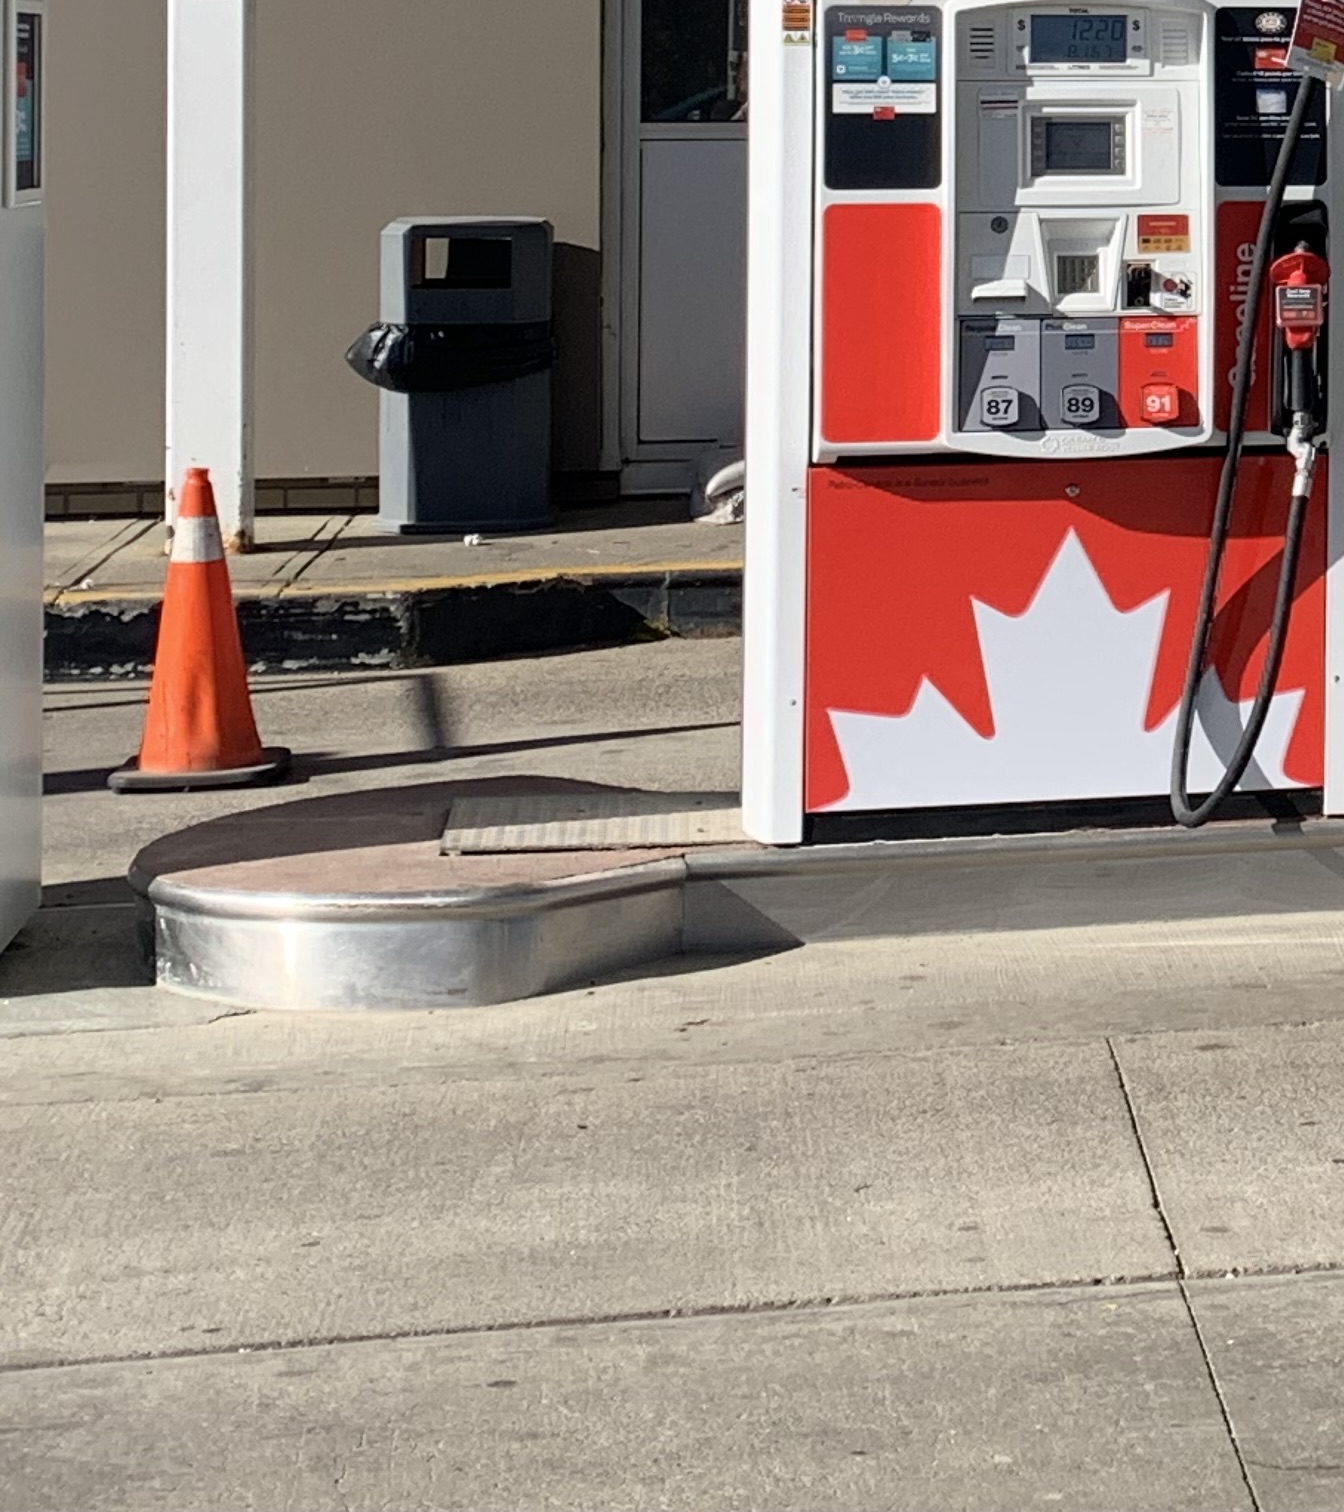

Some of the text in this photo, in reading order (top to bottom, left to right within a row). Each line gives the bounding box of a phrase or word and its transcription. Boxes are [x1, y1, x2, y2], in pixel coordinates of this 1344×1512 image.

[837, 12, 931, 26] Triangle Rewards
[1016, 18, 1027, 32] $
[1131, 18, 1142, 32] $
[986, 399, 1013, 415] 87
[1067, 397, 1095, 413] 89
[1146, 397, 1171, 412] 91
